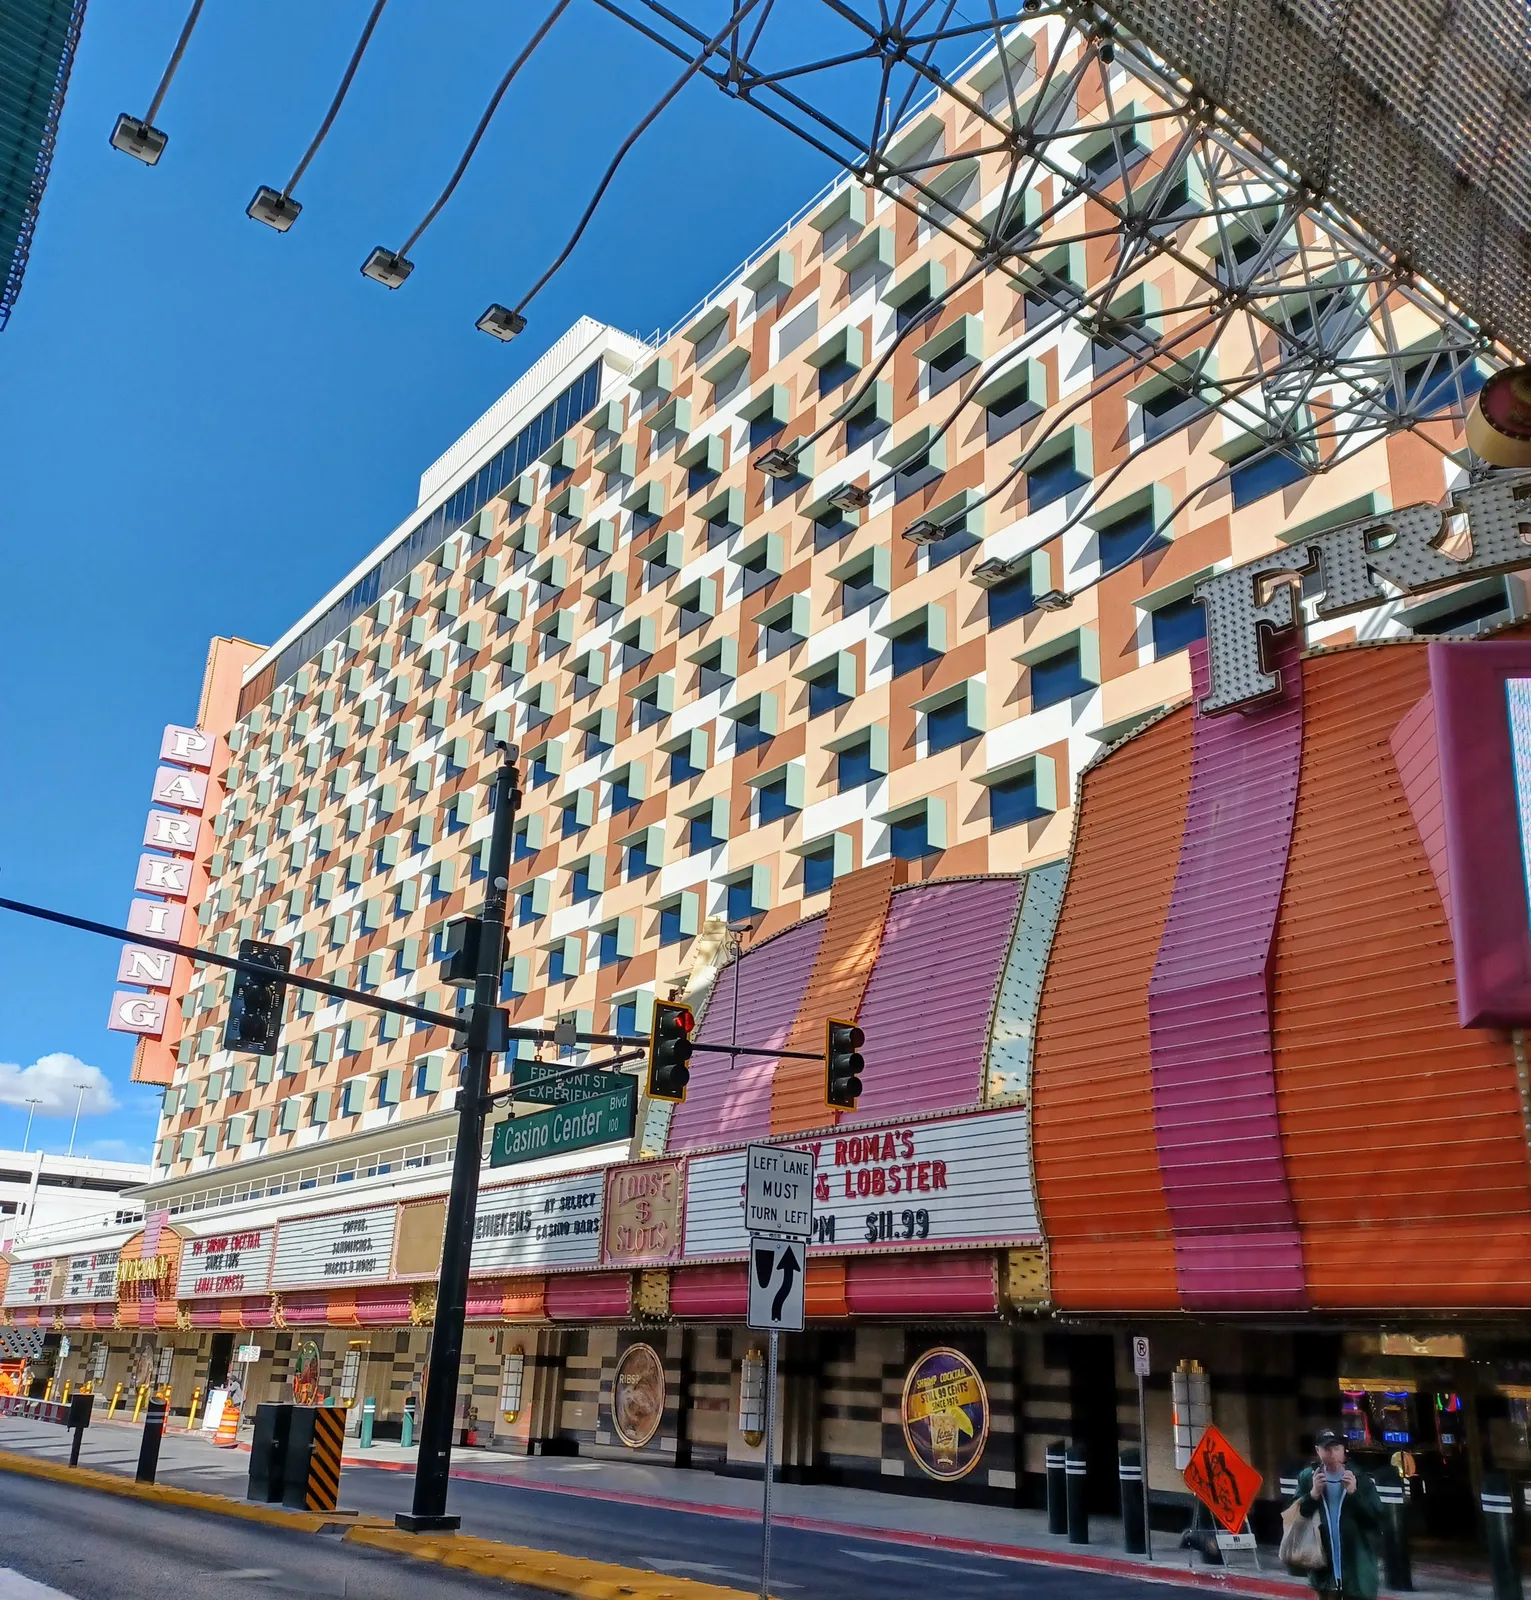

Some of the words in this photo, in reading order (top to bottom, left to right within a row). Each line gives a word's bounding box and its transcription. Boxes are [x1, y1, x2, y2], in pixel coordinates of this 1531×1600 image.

[118, 730, 208, 1028] PARKING
[530, 1066, 590, 1086] FREONT
[593, 1075, 608, 1089] ST
[529, 1086, 605, 1102] EXPERIEN
[496, 1127, 501, 1139] S
[504, 1121, 549, 1155] Casino
[553, 1107, 603, 1143] Center
[609, 1094, 628, 1111] Blvd
[608, 1117, 619, 1132] 100
[834, 1129, 914, 1167] ROMA'S
[753, 1156, 778, 1171] LEFT
[783, 1161, 809, 1176] LANE
[618, 1172, 671, 1207] LOOSE
[763, 1180, 799, 1200] MUST
[815, 1173, 830, 1202] &
[845, 1160, 948, 1199] LOBSTER
[544, 1198, 556, 1214] AT
[559, 1192, 596, 1212] SELECT
[635, 1199, 652, 1225] $
[750, 1205, 777, 1221] TURN
[785, 1210, 808, 1225] LEFT
[536, 1221, 570, 1241] CASINO
[573, 1217, 600, 1235] BARS
[616, 1220, 668, 1254] SLOTS
[865, 1209, 929, 1244] $11.99
[619, 1373, 639, 1384] RIBS?
[916, 1375, 937, 1389] SHRIMP
[940, 1368, 966, 1383] COCKTAIL
[921, 1391, 938, 1404] STILL
[938, 1387, 947, 1400] 99
[947, 1382, 968, 1396] CENTS
[932, 1400, 946, 1410] SINCE
